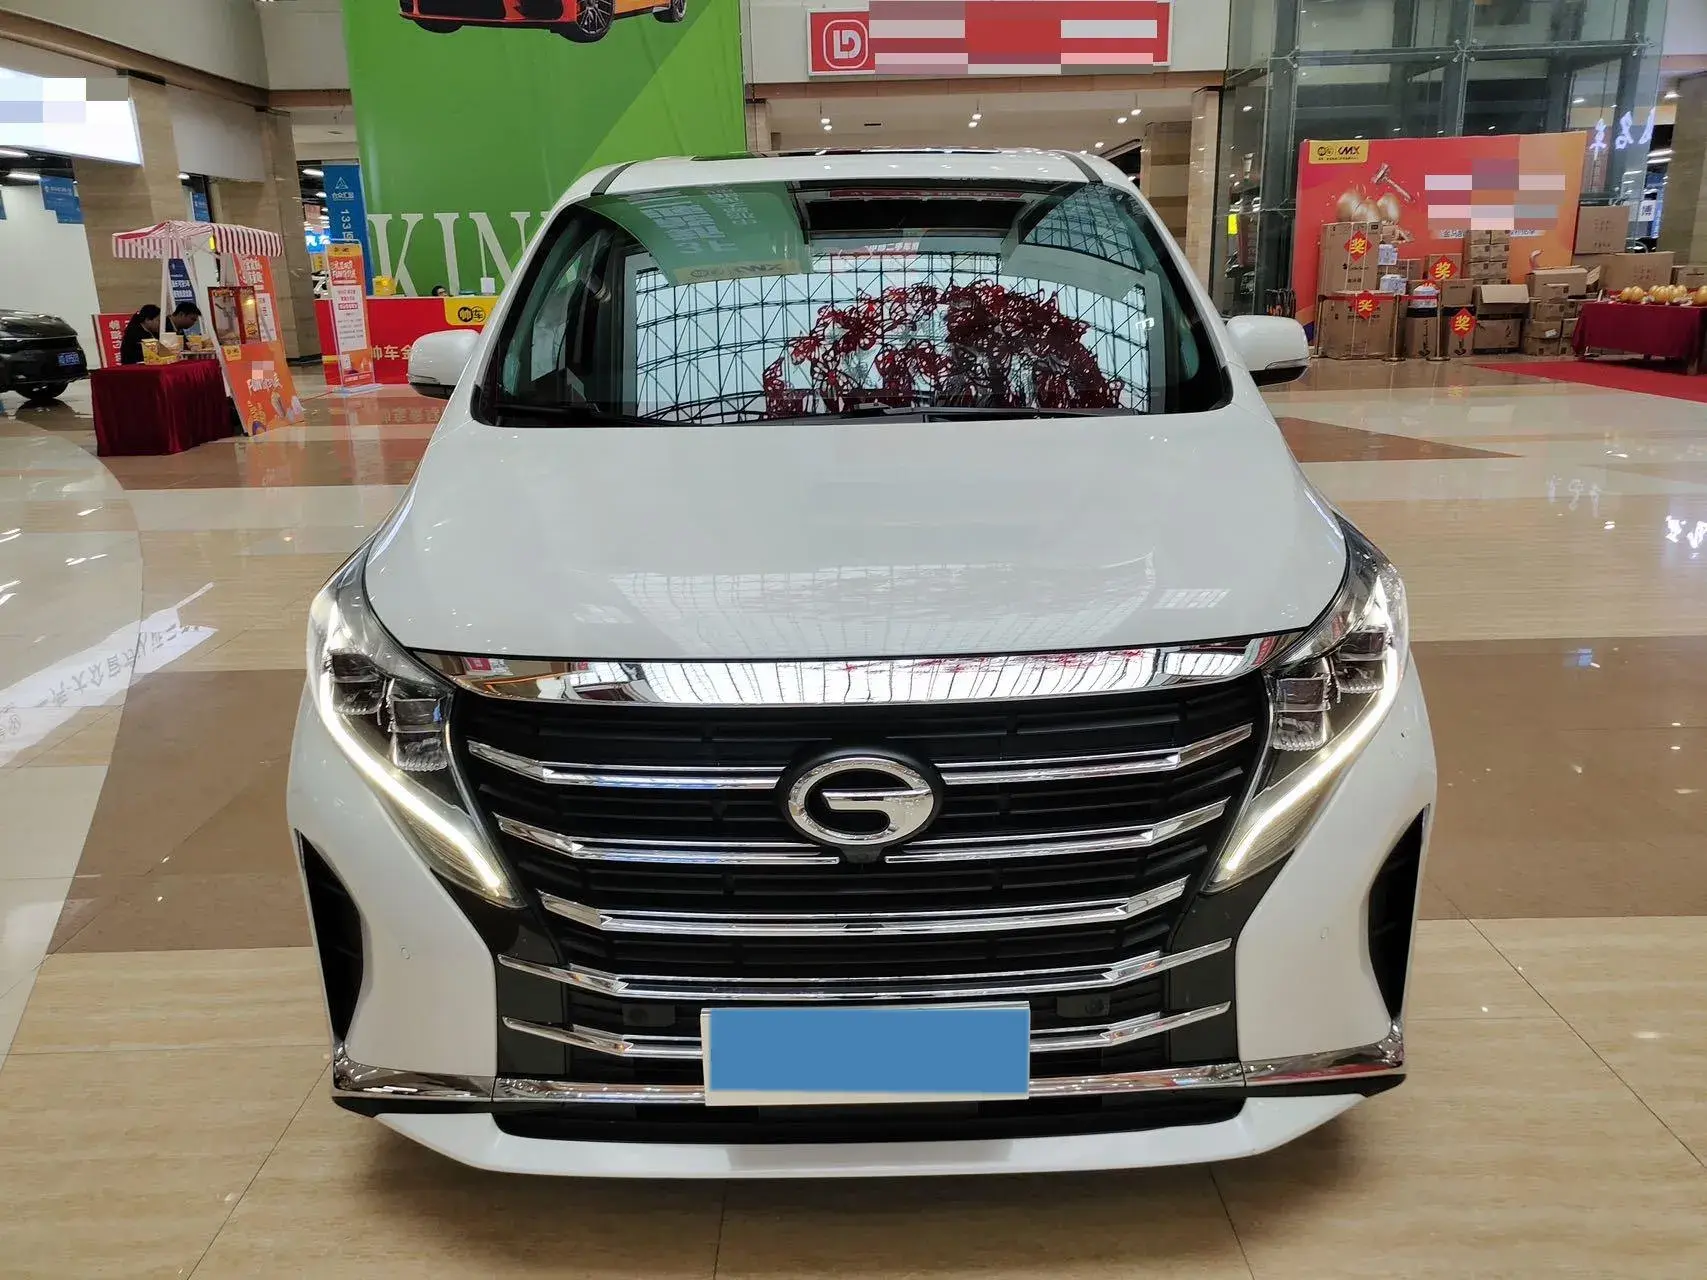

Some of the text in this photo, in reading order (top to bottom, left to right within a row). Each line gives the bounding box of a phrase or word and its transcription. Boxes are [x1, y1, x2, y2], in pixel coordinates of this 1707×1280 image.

[1350, 237, 1367, 254] 奖
[1434, 261, 1452, 279] 奖
[1454, 315, 1470, 331] 奖
